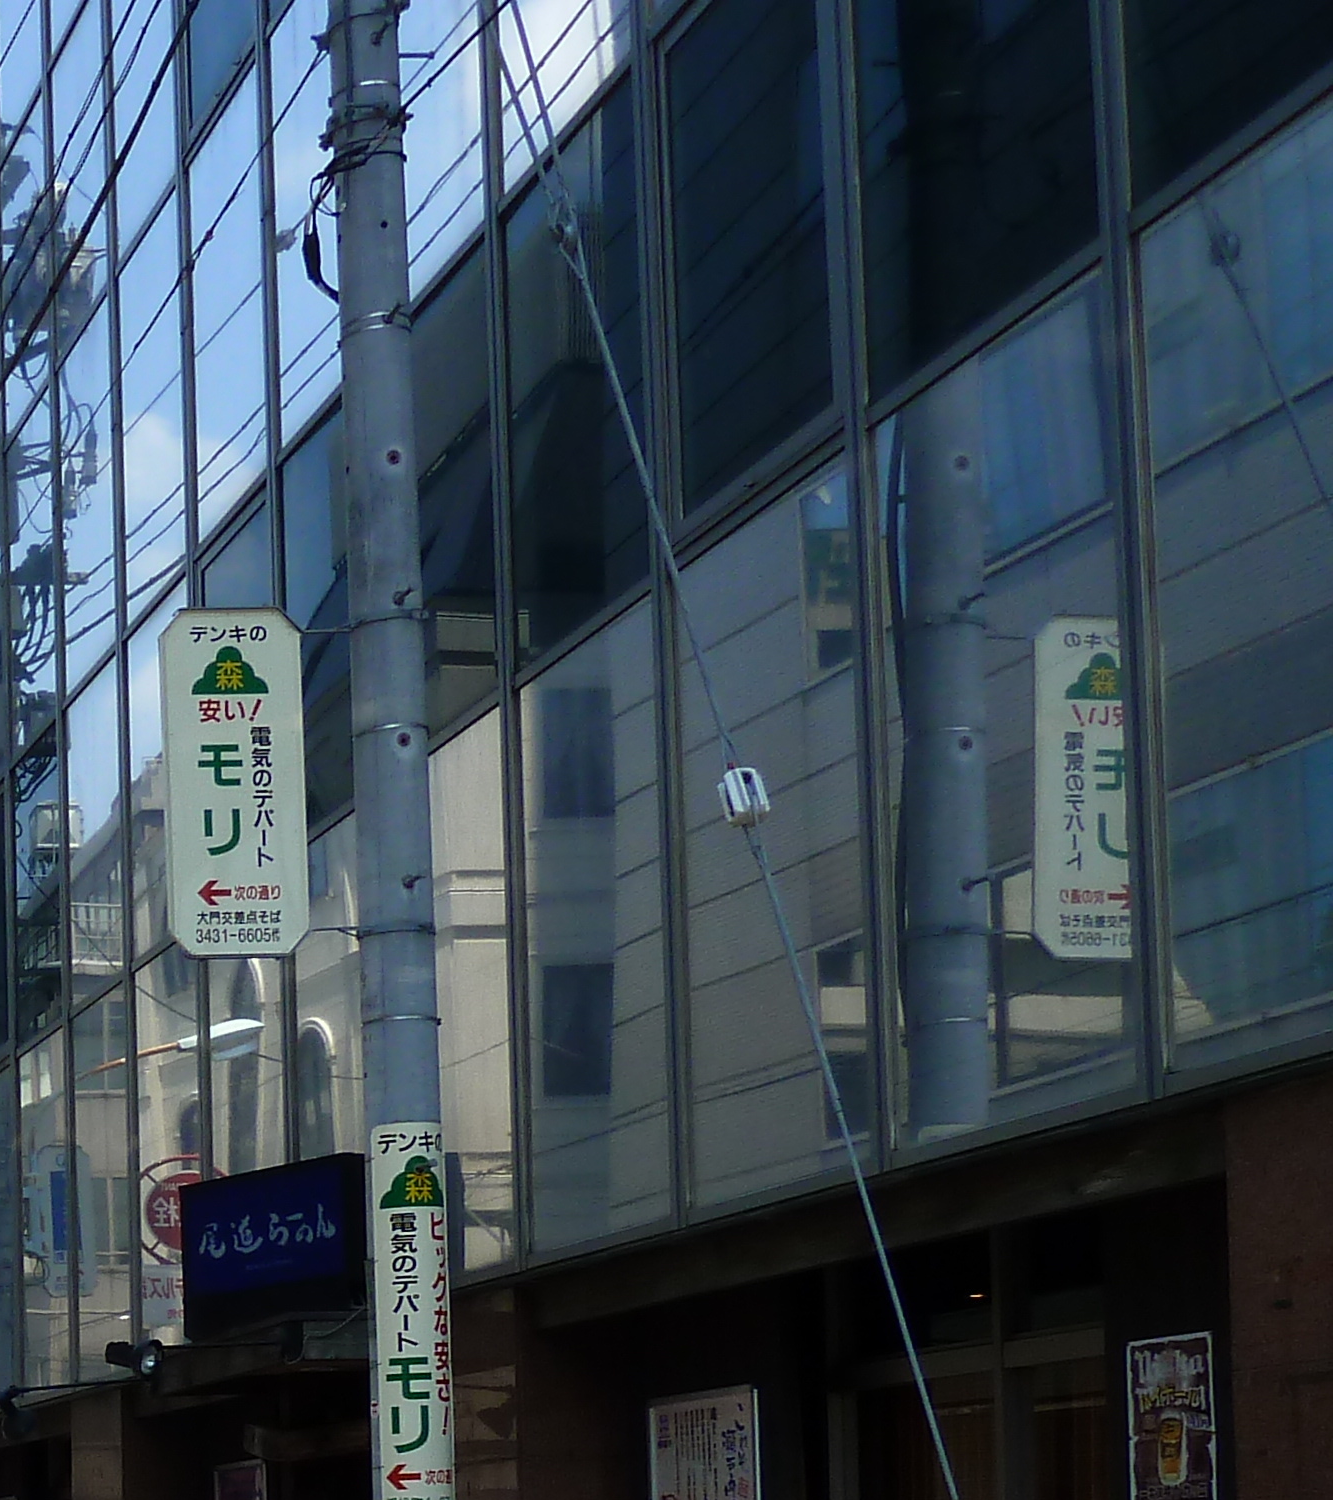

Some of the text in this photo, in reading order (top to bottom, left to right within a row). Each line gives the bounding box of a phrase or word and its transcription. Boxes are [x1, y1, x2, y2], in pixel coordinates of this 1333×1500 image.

[189, 625, 268, 644] テンキの
[215, 661, 245, 690] 森
[198, 744, 244, 857] モリ
[250, 726, 275, 868] 電気のデパート
[234, 884, 282, 901] 次の通り
[197, 910, 282, 927] 大門交差点そば
[405, 1173, 434, 1204] 森
[389, 1212, 420, 1353] 電気のデパート
[386, 1356, 432, 1454] モリ
